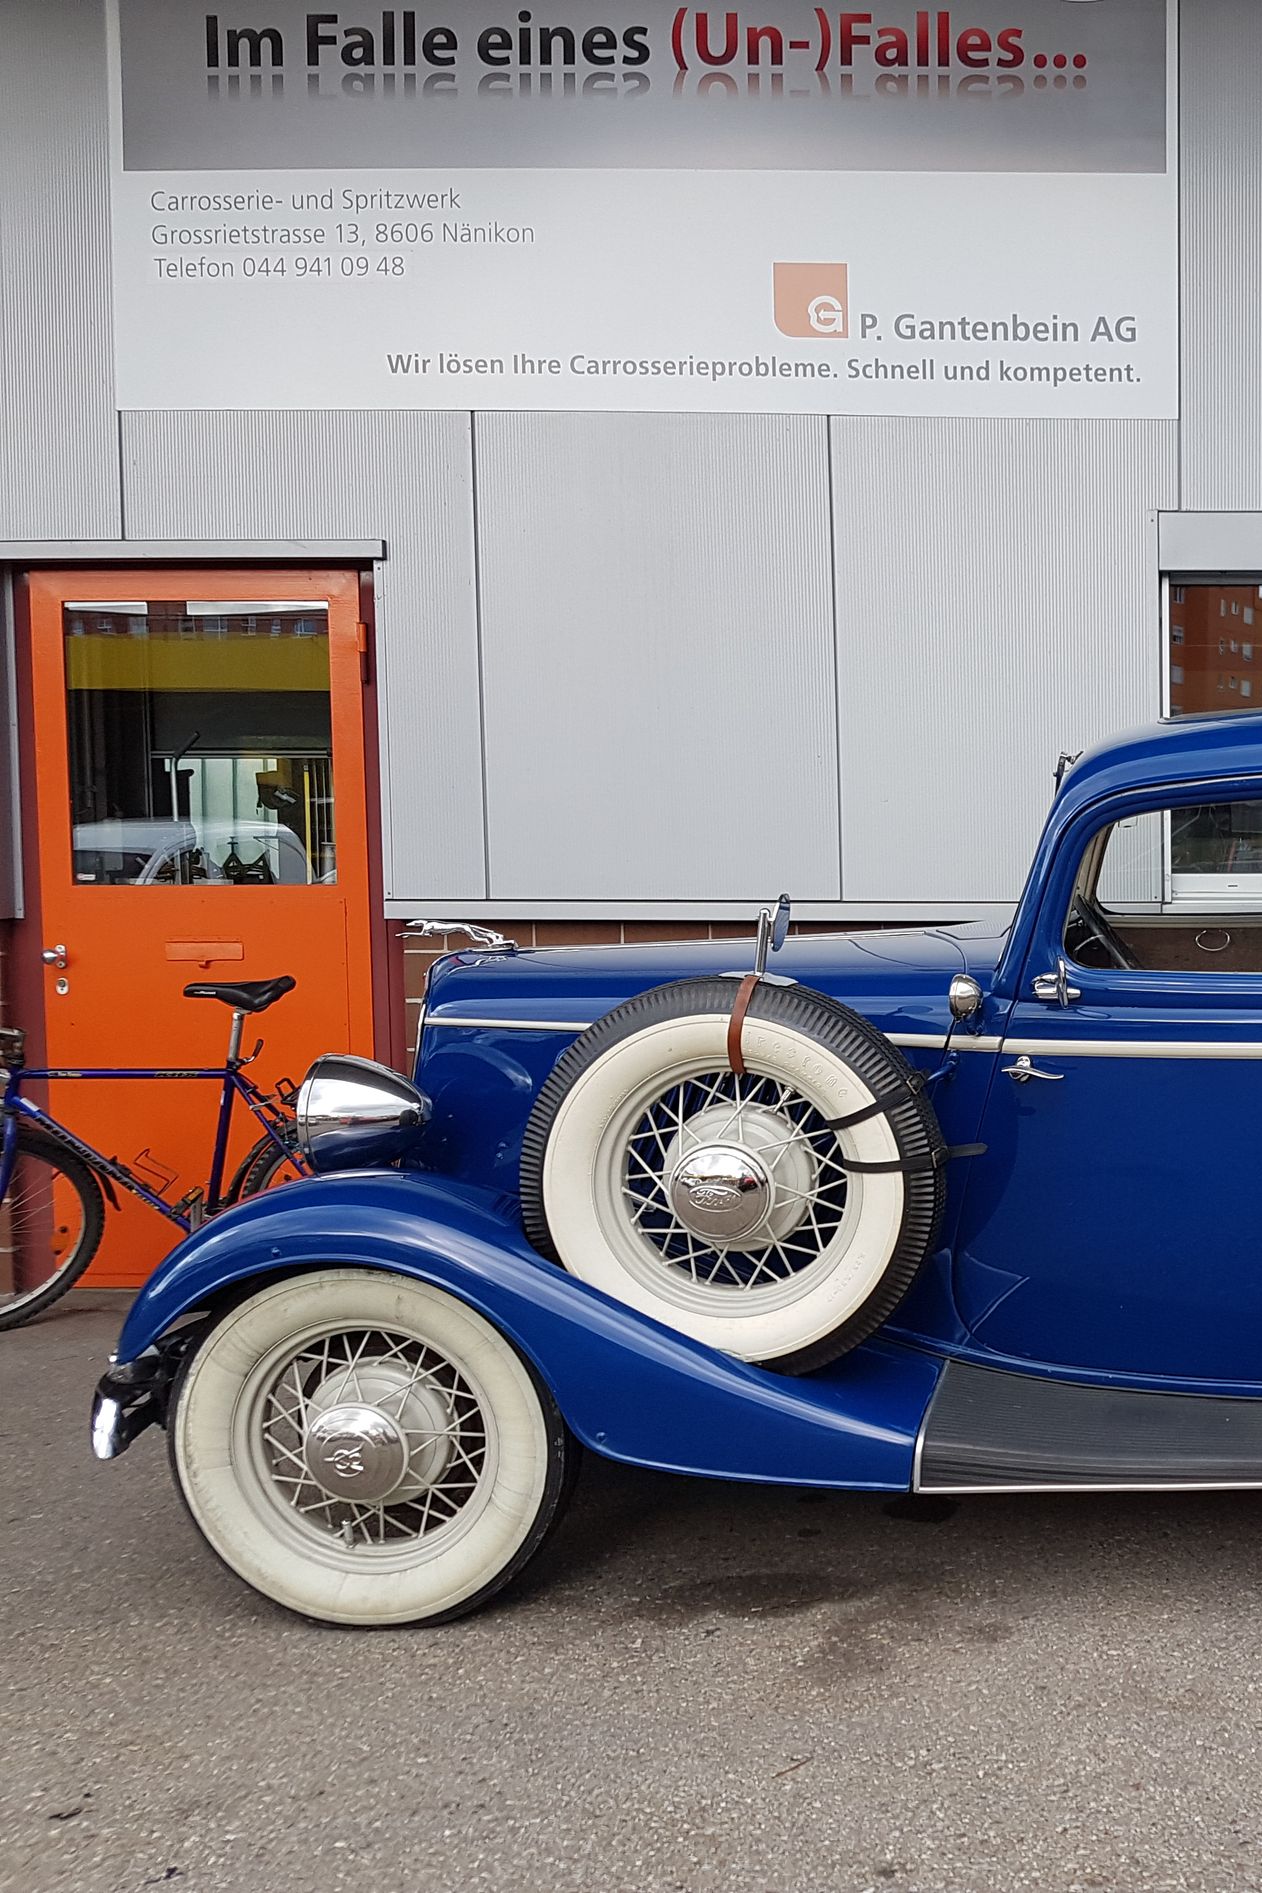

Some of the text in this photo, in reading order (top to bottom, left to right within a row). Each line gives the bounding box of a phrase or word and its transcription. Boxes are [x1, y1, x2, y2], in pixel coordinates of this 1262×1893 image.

[206, 7, 1087, 72] Im Falle eines (Un-)Falles...
[151, 187, 462, 214] Carrosserie- und Spritzwerk
[151, 220, 536, 248] Grossrietstrasse 13, 8606 Nänikon
[154, 255, 406, 279] Telefon 044 941 09 48
[860, 313, 883, 341] P.
[893, 312, 1079, 343] Gantenbein
[1090, 316, 1137, 343] AG
[387, 353, 1141, 387] Wir lösen Ihre Carrosserieprobleme. Schnell und kompetent.
